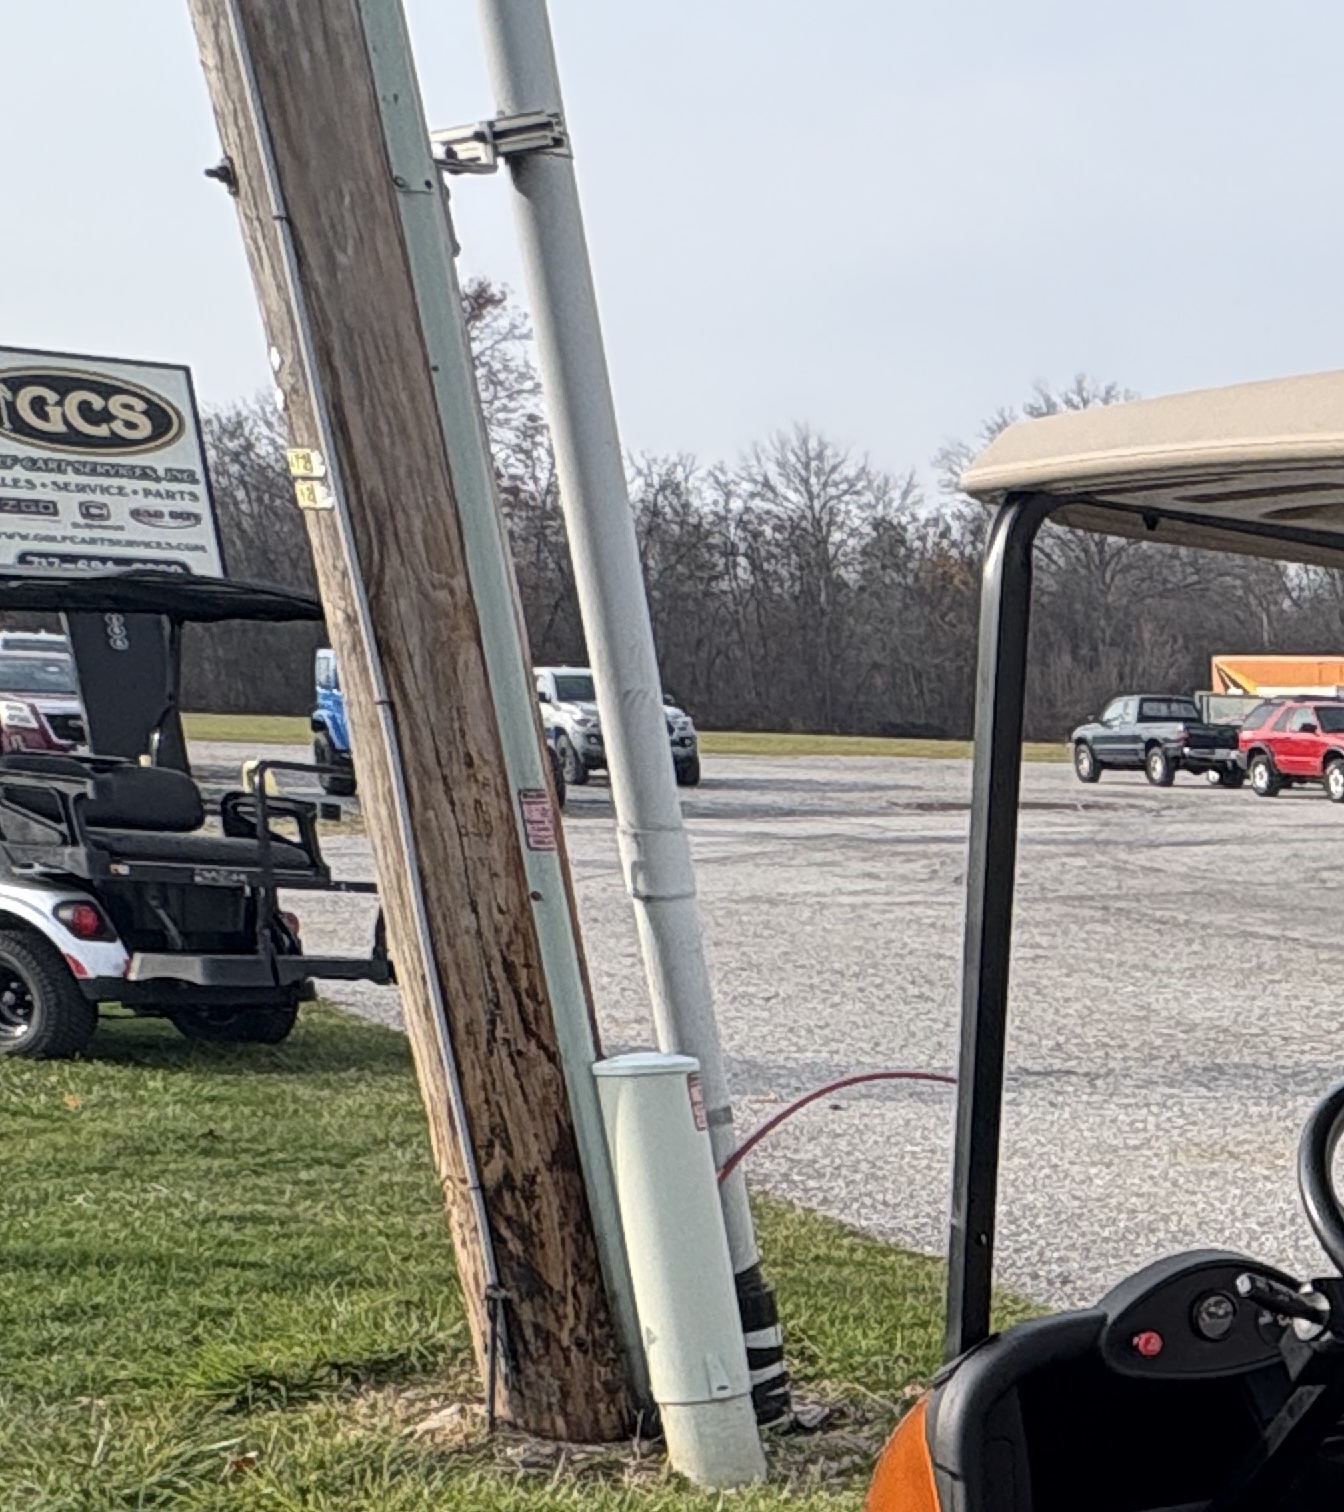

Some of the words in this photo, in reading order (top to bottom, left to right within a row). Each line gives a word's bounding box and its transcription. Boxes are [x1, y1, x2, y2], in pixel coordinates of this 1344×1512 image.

[16, 385, 153, 440] GCS
[50, 480, 129, 497] SERVICE
[142, 487, 200, 503] PARTS
